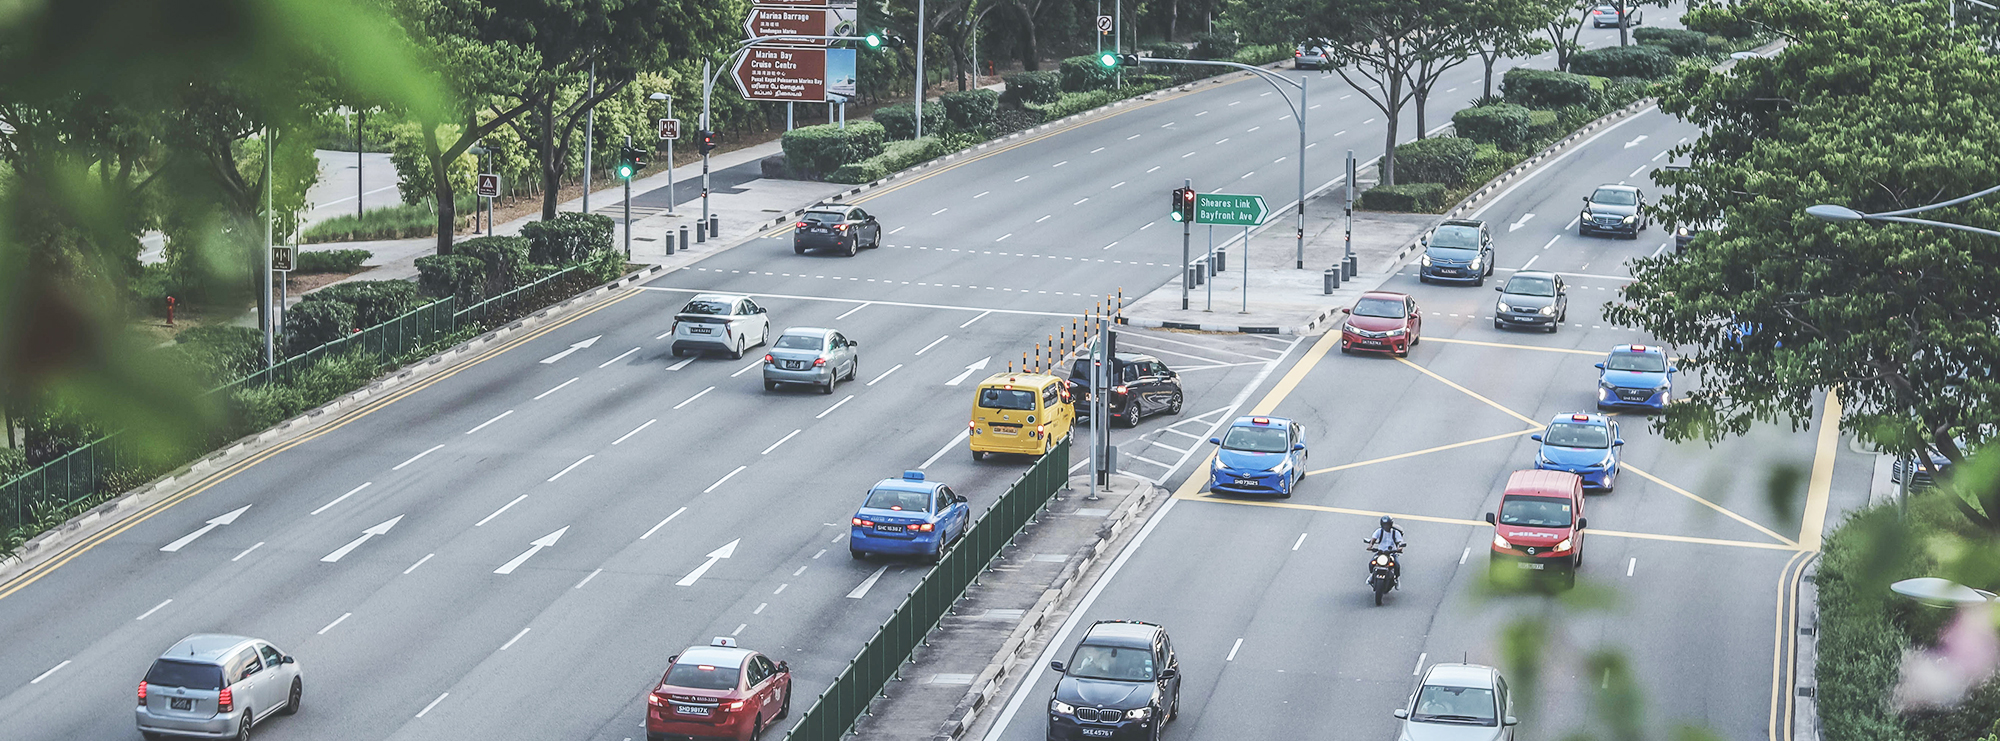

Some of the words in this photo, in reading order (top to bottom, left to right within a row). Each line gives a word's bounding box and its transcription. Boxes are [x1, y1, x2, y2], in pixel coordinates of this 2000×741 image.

[783, 12, 809, 22] Barrage
[780, 52, 792, 60] Bay
[752, 60, 772, 68] Cruise
[775, 61, 796, 69] Centre
[814, 78, 823, 86] Bay
[1201, 198, 1231, 207] Sheares
[1235, 199, 1250, 208] Link
[1201, 210, 1234, 221] Bayfront
[1239, 212, 1252, 220] Ave
